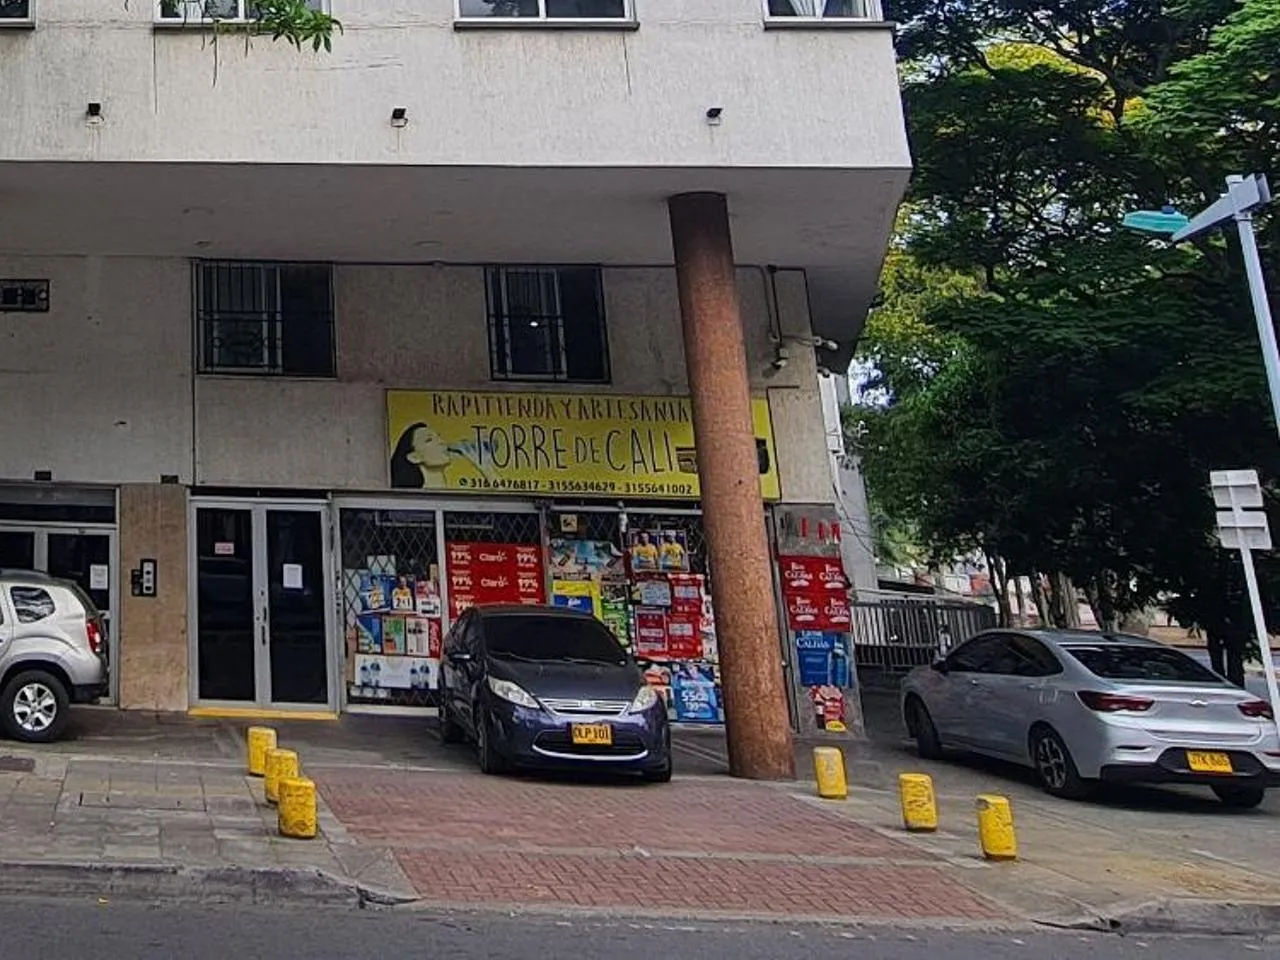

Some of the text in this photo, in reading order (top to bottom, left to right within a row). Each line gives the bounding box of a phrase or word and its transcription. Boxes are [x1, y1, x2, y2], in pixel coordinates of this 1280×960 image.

[432, 393, 557, 420] RAPITIENDA
[471, 423, 673, 475] TORRE DE CALI
[481, 577, 505, 588] Claro
